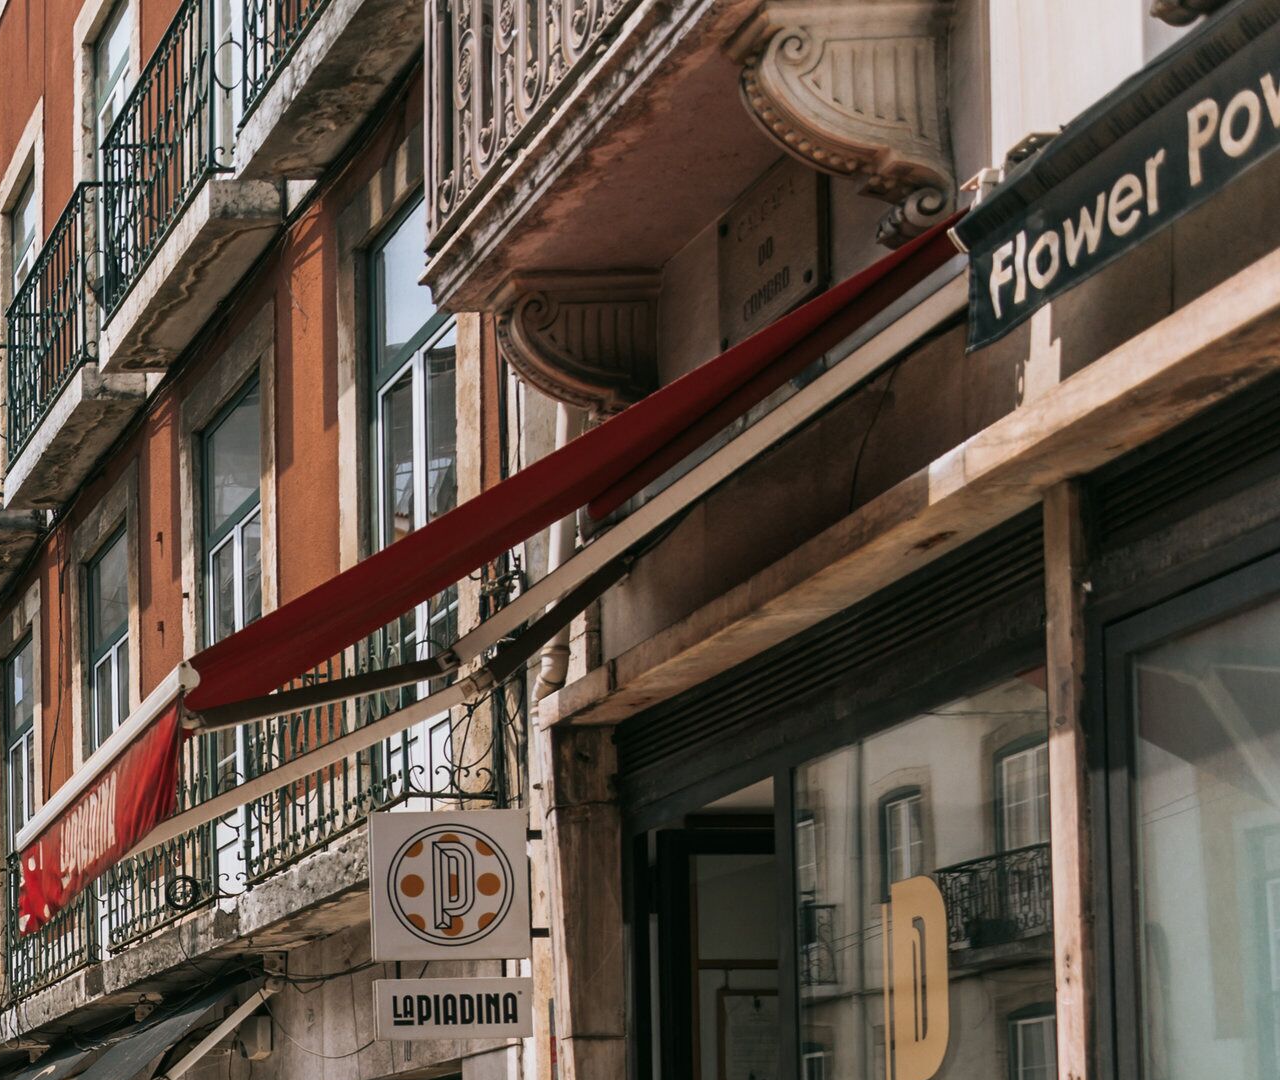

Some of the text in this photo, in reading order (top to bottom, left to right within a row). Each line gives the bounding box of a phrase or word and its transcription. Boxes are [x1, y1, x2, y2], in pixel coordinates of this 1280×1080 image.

[758, 235, 773, 267] DO
[989, 146, 1166, 320] Flower
[743, 265, 790, 322] COMBRO
